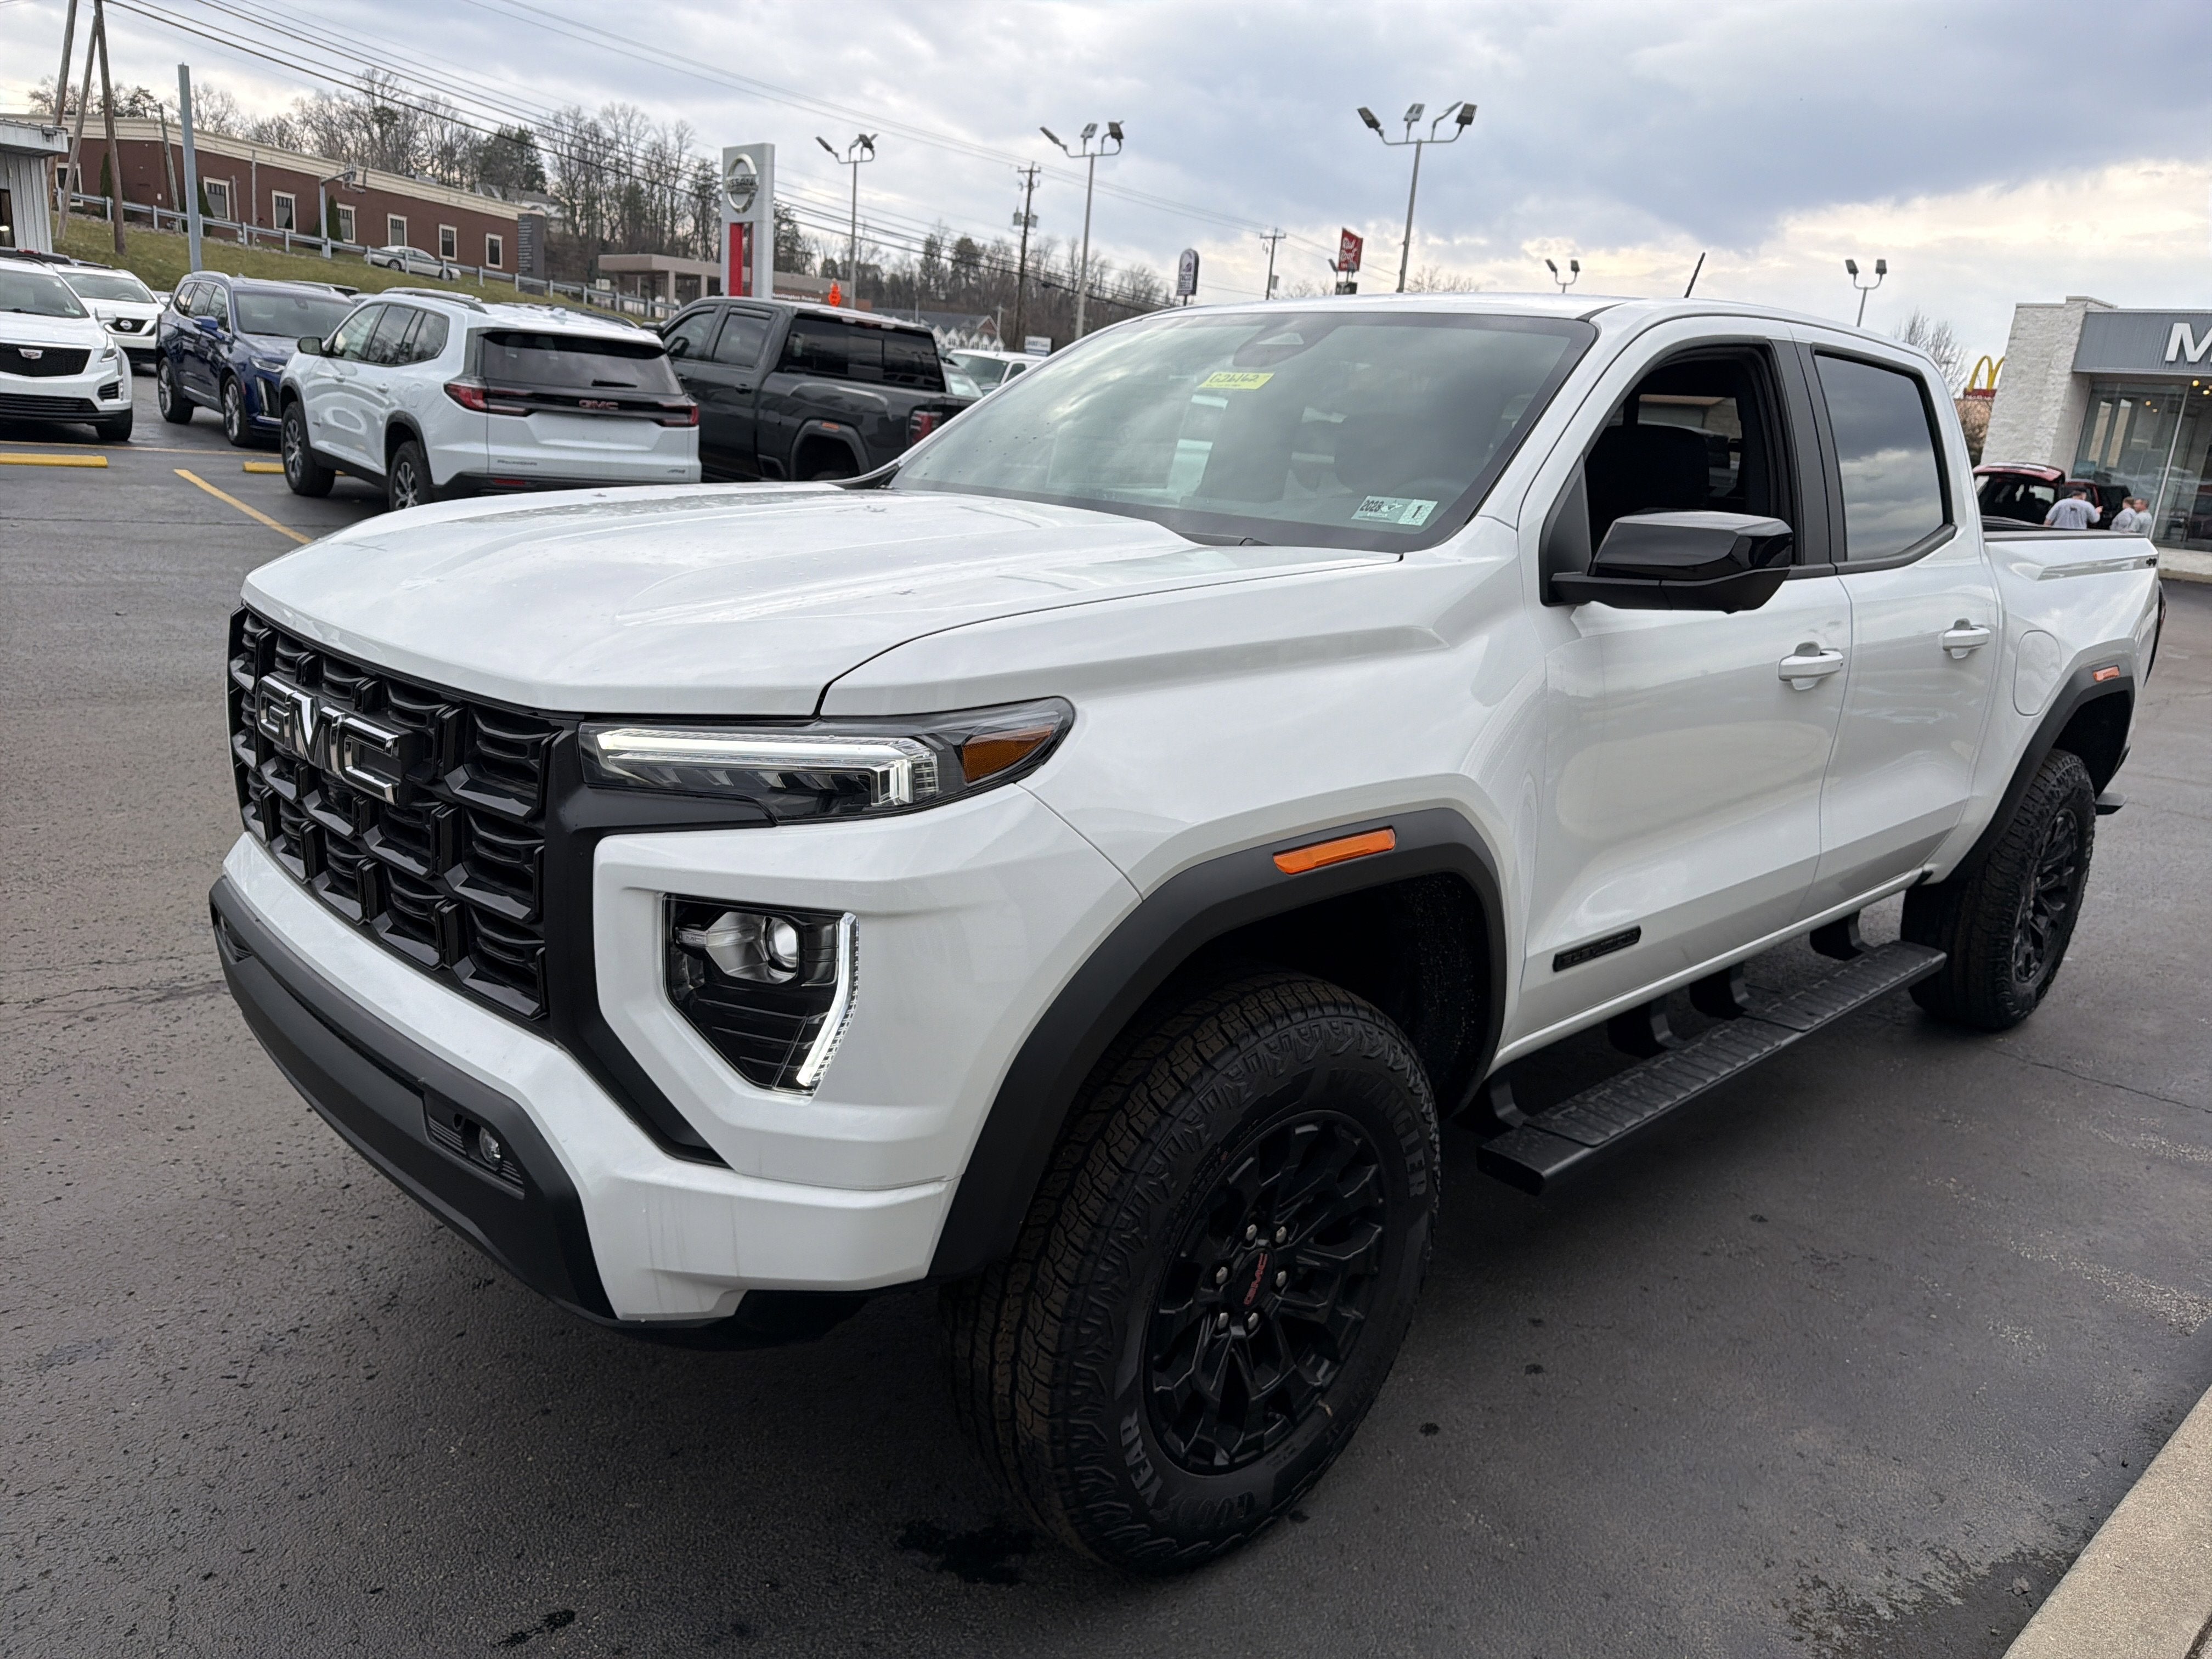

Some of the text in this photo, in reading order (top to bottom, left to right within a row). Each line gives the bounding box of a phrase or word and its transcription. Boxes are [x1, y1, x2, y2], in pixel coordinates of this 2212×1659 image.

[579, 399, 619, 410] GMC
[1412, 505, 1423, 518] 1
[255, 675, 399, 805] GMC
[1243, 1252, 1268, 1306] GMC
